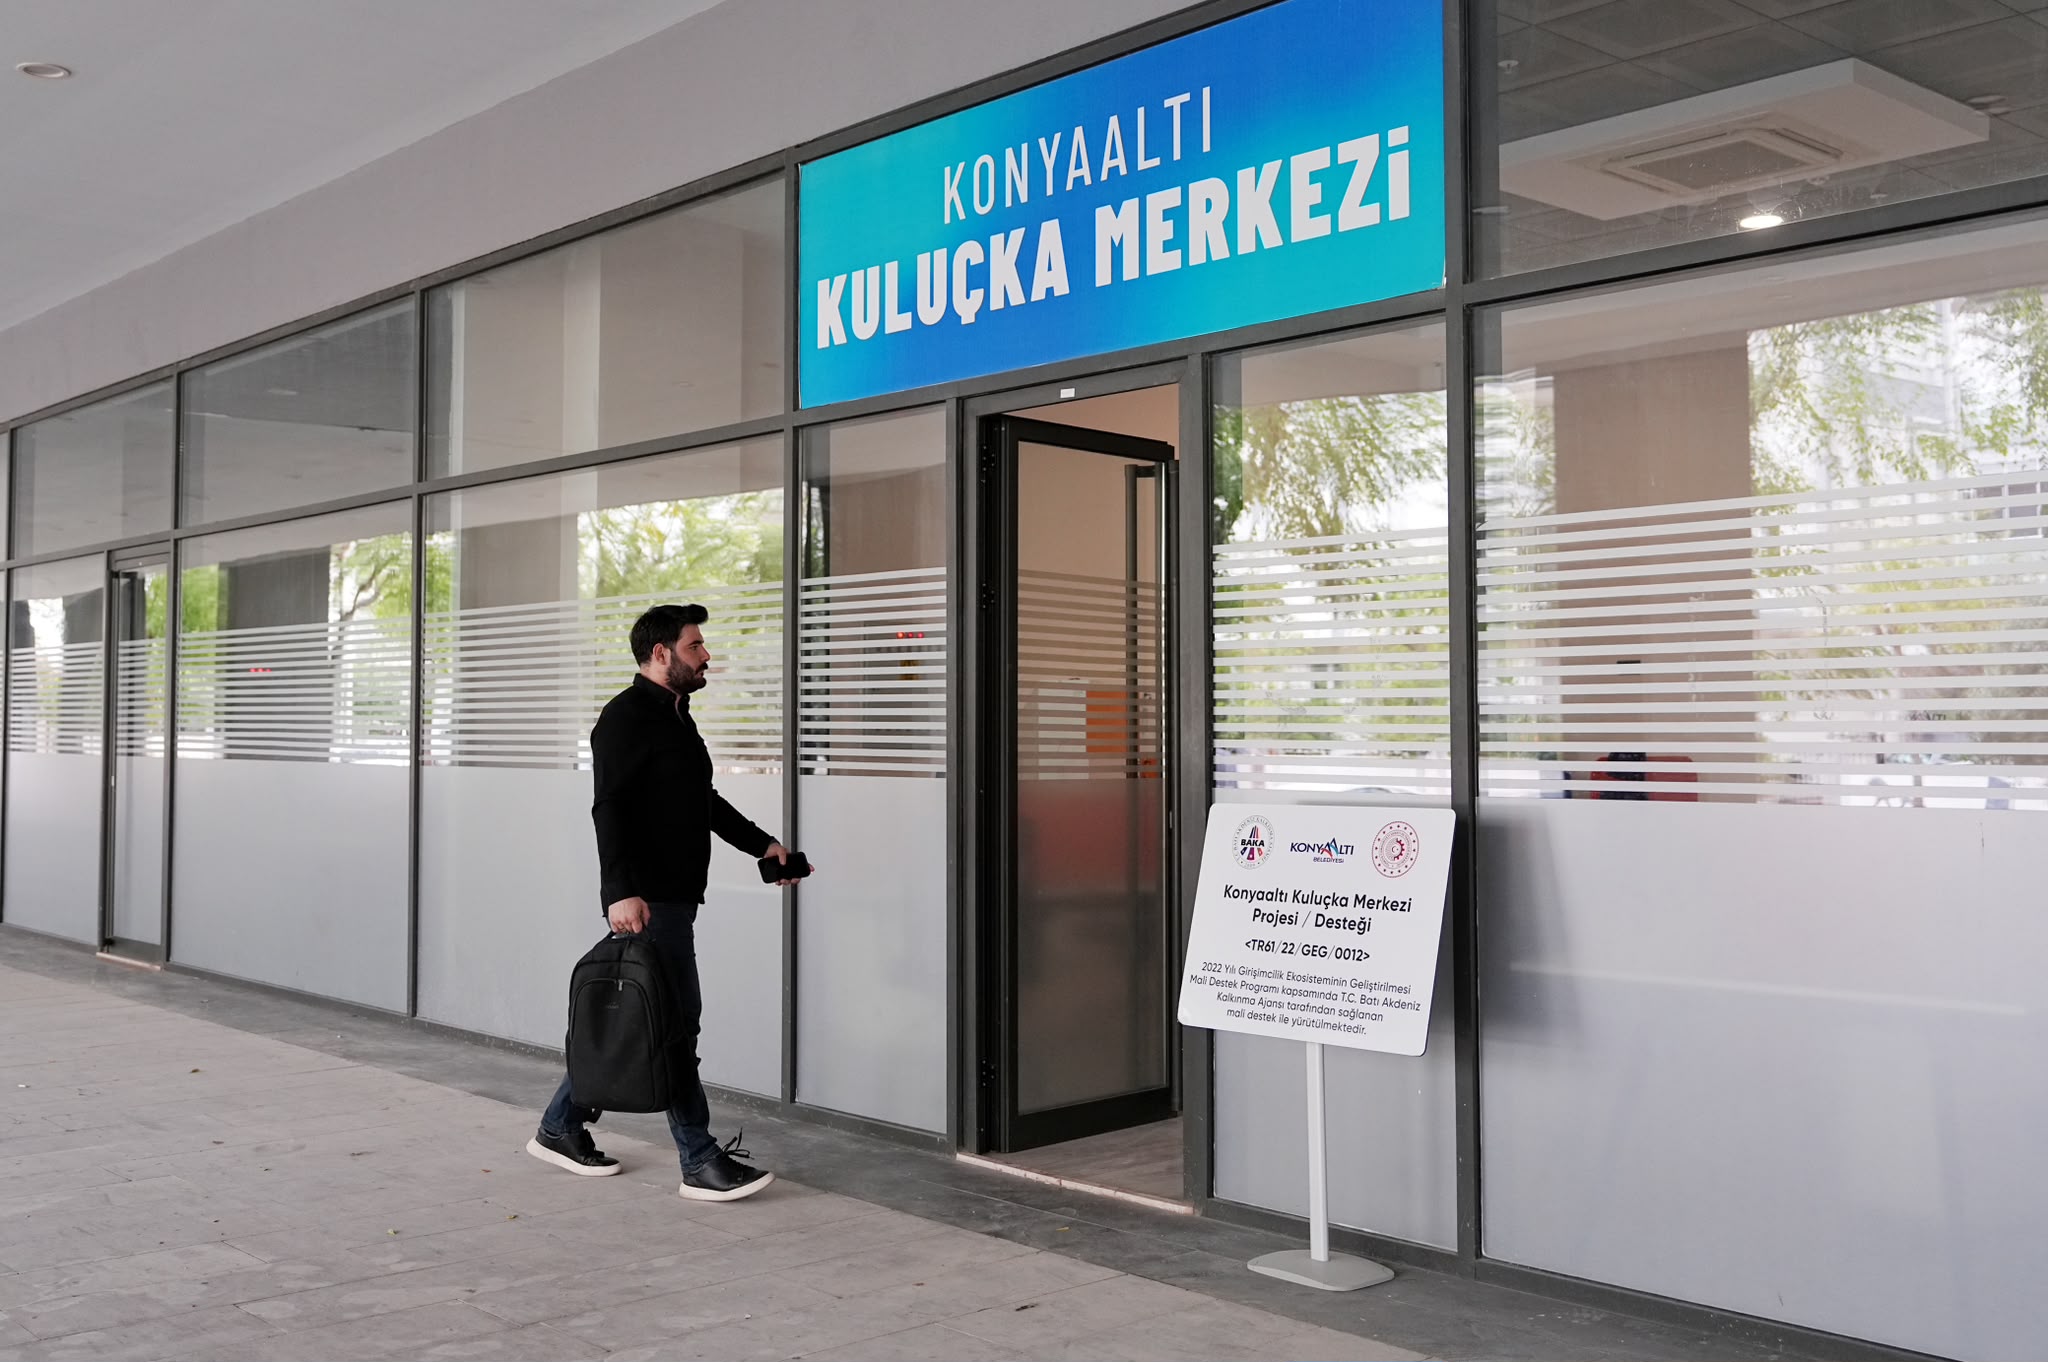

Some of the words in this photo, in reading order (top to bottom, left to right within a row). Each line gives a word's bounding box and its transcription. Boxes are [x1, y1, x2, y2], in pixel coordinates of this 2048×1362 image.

[944, 86, 1212, 224] KONYAALTI
[816, 219, 1070, 349] KULUÇKA
[1095, 125, 1411, 287] MERKEZİ
[1241, 838, 1265, 847] BAKA
[1290, 837, 1354, 856] KONYAALTI
[1223, 884, 1288, 904] Konyaaltı
[1292, 889, 1349, 910] Kuluçka
[1353, 893, 1412, 913] Merkezi
[1252, 907, 1299, 928] Projesi
[1301, 910, 1312, 928] /
[1314, 913, 1372, 936] Desteği
[1245, 938, 1370, 962] <TR61/22/GEG/0012>
[1201, 961, 1223, 973] 2022
[1224, 964, 1236, 975] Yılı
[1238, 965, 1284, 980] Girişimcilik
[1286, 971, 1347, 987] Ekosisteminin
[1349, 978, 1412, 995] Geliştirilmesi
[1189, 974, 1208, 985] Mali
[1209, 976, 1238, 989] Destek
[1240, 980, 1280, 994] Programı
[1281, 985, 1338, 1001] kapsamında
[1341, 991, 1357, 1004] T.C.
[1360, 994, 1380, 1006] Batı
[1381, 997, 1422, 1012] Akdeniz
[1216, 991, 1256, 1006] Kalkınma
[1257, 997, 1285, 1009] Ajansı
[1286, 1001, 1336, 1016] tarafından
[1338, 1008, 1384, 1022] sağlanan
[1226, 1008, 1245, 1018] mali
[1247, 1010, 1277, 1023] destek
[1278, 1013, 1289, 1024] ile
[1291, 1016, 1367, 1035] yürütülmektedir.
